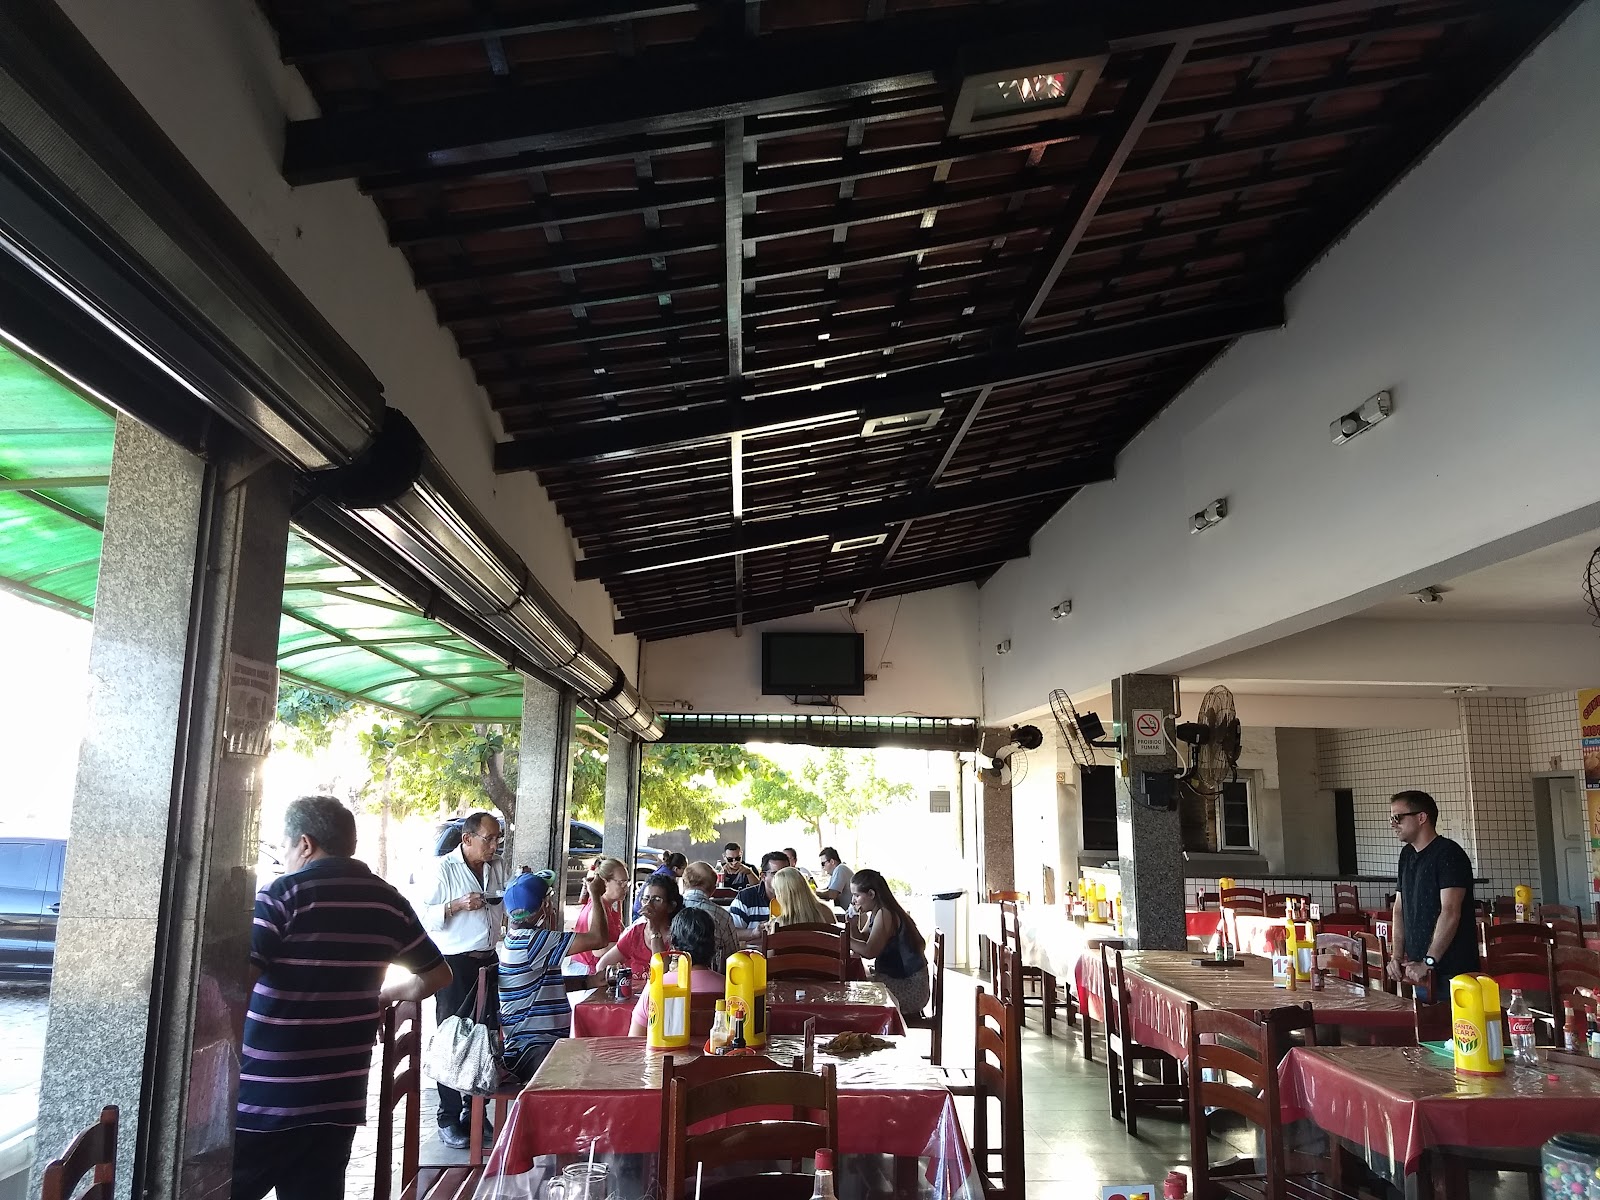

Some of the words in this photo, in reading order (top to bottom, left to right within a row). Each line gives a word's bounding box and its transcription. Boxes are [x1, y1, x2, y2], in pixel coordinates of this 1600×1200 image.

[1311, 906, 1318, 915] 17
[1376, 924, 1387, 936] 16
[1454, 1022, 1474, 1030] SANTA
[1455, 1029, 1476, 1037] CLARA
